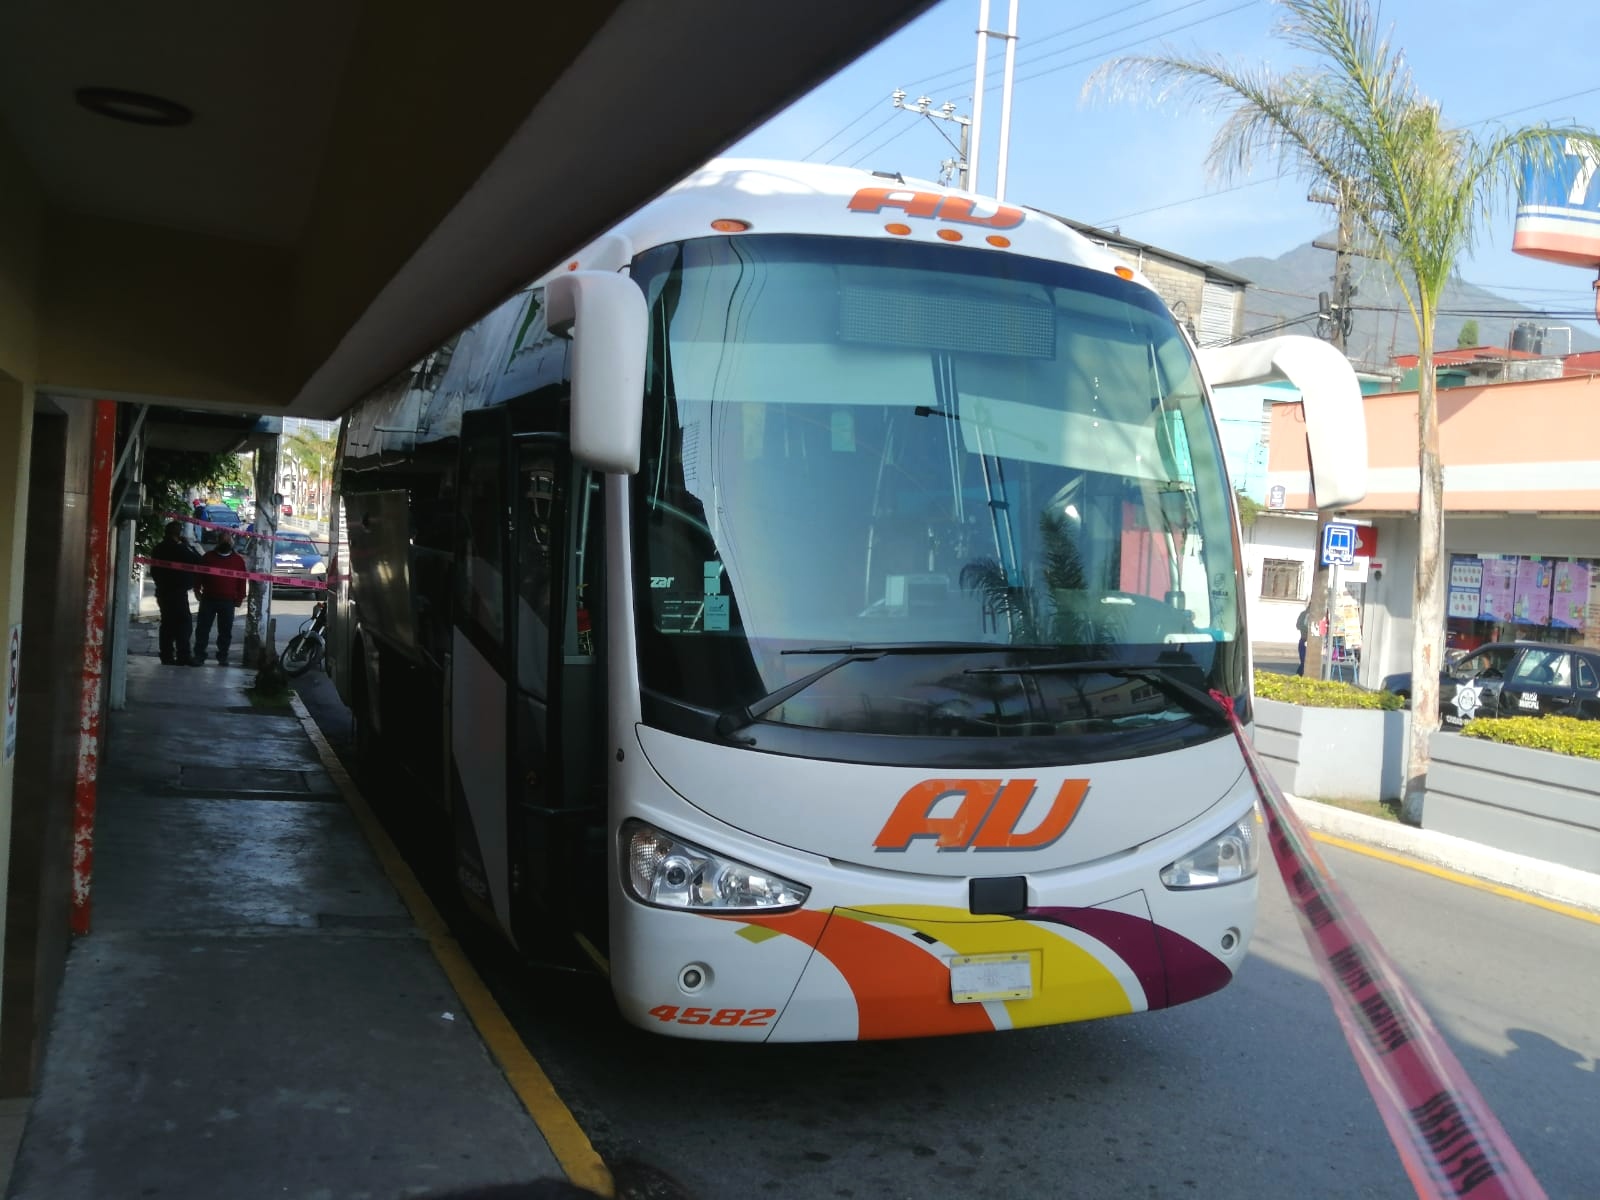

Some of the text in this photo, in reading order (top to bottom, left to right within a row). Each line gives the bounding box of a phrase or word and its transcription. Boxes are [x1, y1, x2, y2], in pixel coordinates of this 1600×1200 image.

[1565, 137, 1599, 205] 7
[847, 187, 1026, 230] AU
[872, 778, 1091, 853] AU
[648, 1005, 777, 1027] 4582
